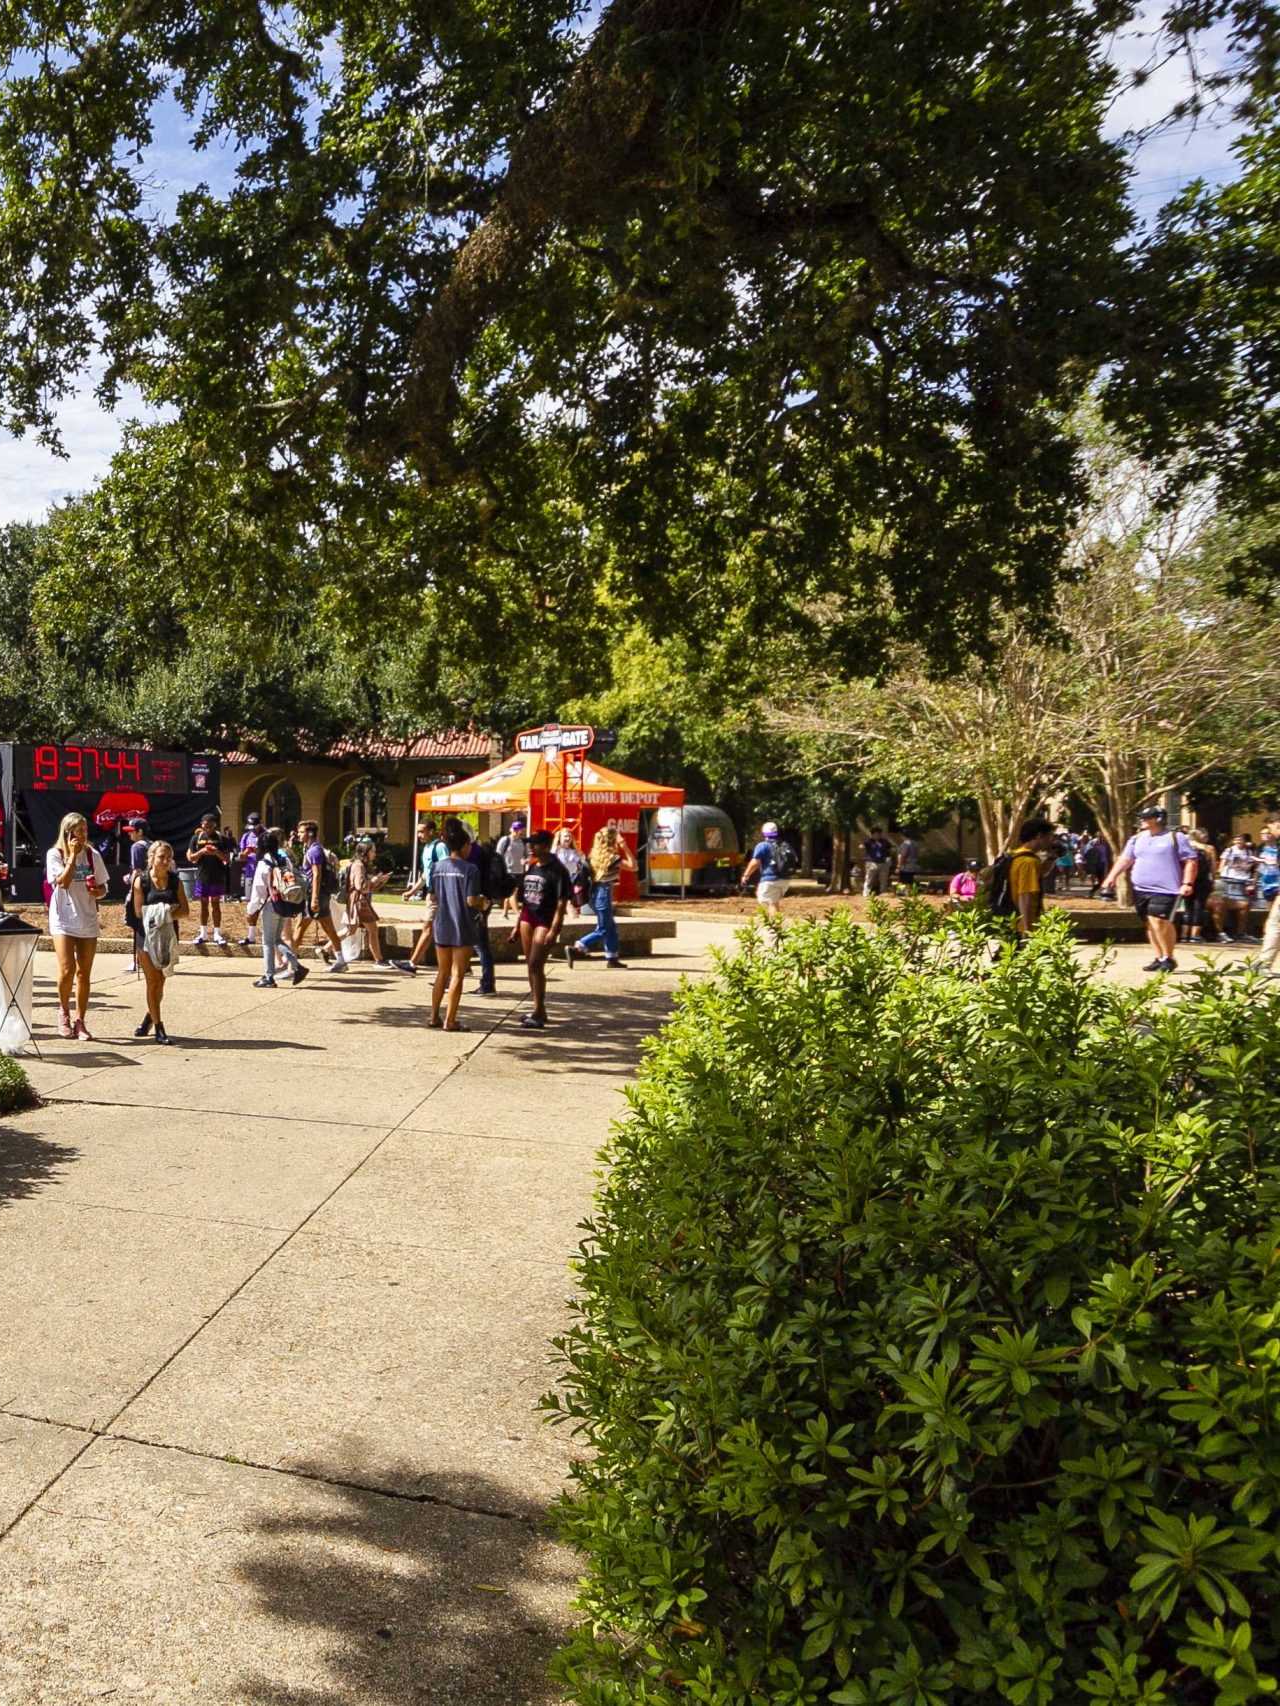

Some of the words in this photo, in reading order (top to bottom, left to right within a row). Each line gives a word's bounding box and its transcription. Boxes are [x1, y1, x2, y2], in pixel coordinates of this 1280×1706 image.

[561, 730, 589, 747] GATE
[583, 792, 617, 804] HOME
[620, 793, 660, 805] DEPOT
